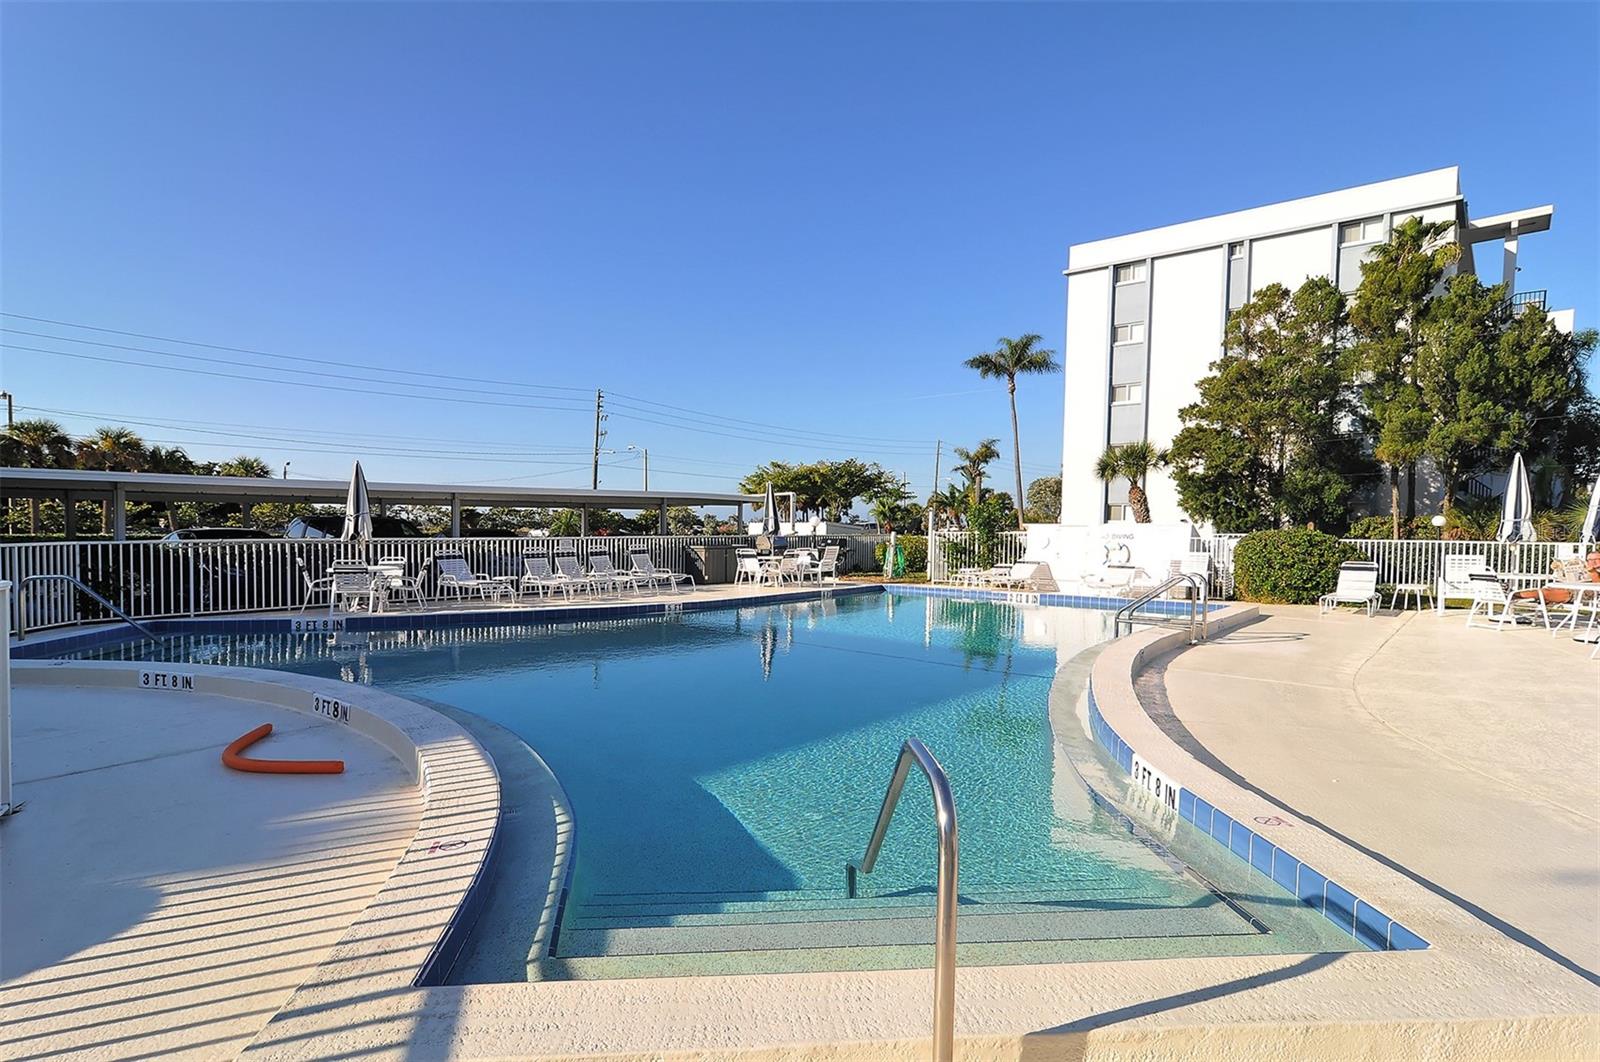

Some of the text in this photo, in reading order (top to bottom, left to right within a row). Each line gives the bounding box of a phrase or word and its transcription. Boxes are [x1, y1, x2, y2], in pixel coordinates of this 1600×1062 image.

[295, 620, 302, 632] 3
[322, 620, 329, 632] 8
[142, 672, 150, 686] 3
[171, 674, 178, 688] 8
[314, 696, 320, 712] 3
[332, 700, 340, 718] 8
[1134, 760, 1140, 780] 3
[1155, 777, 1162, 798] 8
